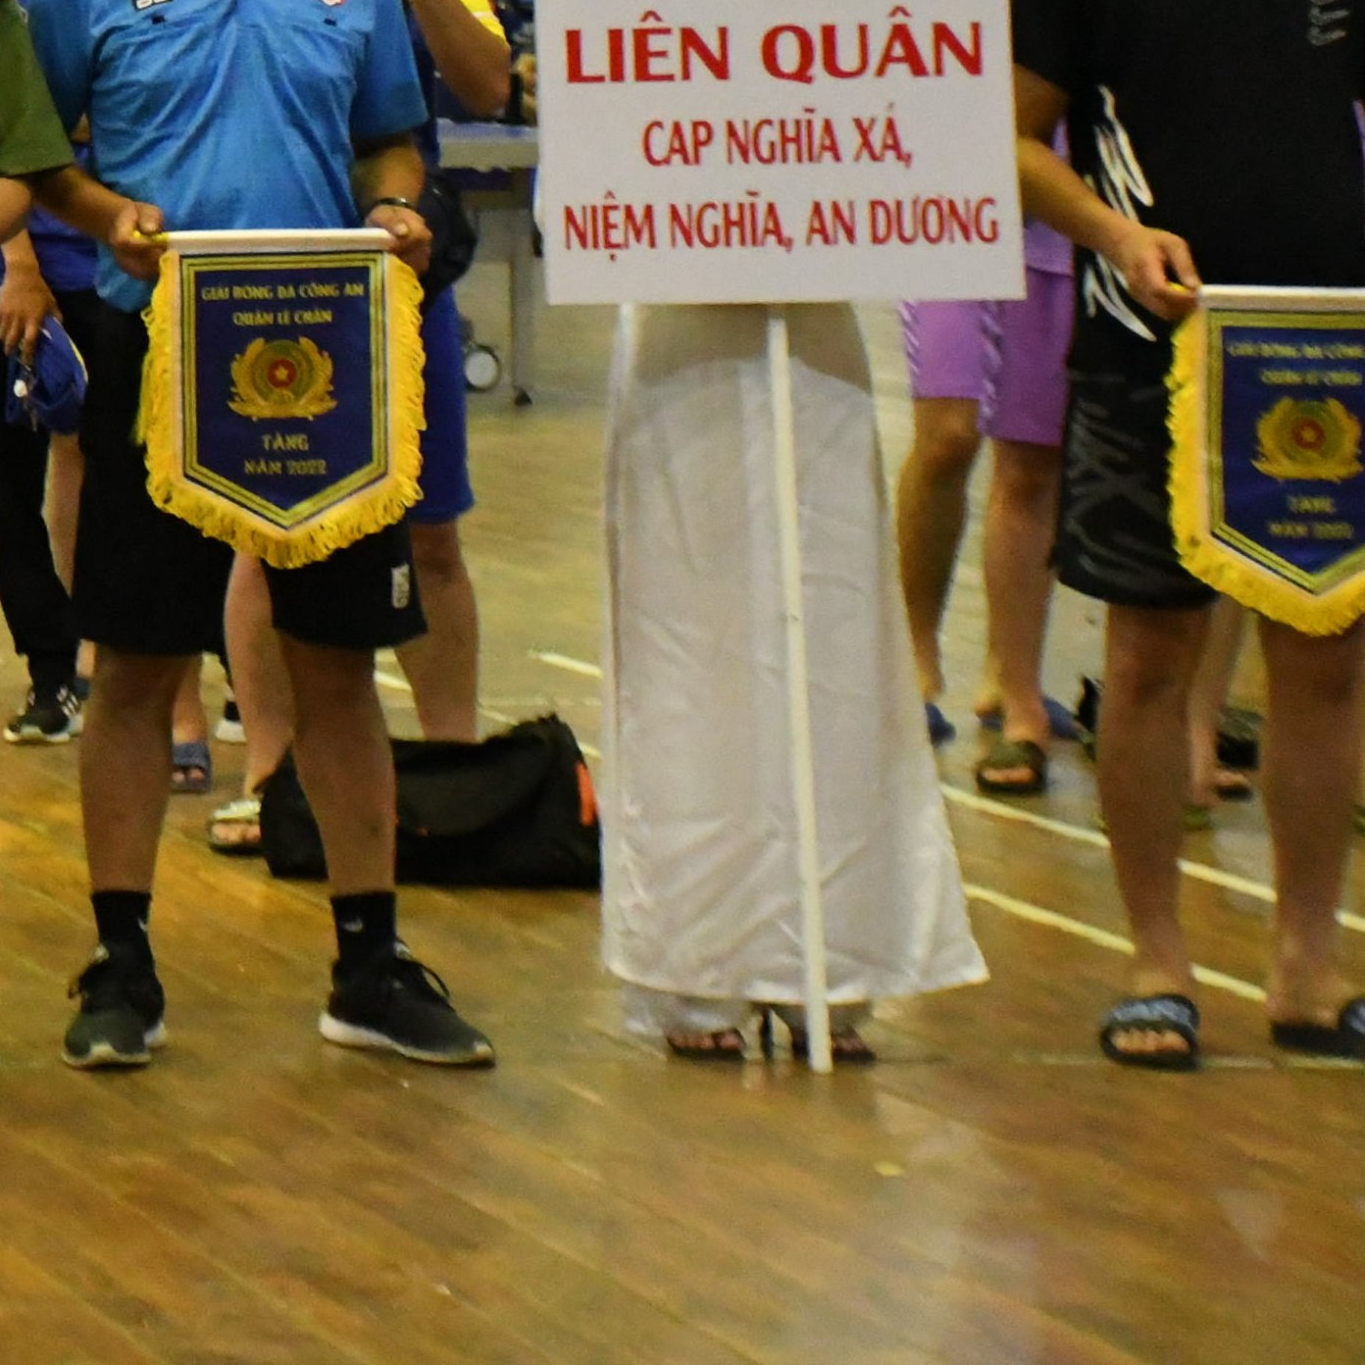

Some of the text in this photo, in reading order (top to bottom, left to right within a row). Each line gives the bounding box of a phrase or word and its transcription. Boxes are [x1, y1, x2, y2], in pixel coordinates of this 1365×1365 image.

[565, 6, 983, 85] LIÊN QUÂN
[642, 119, 713, 167] CAP
[727, 107, 842, 165] NGHĨA
[563, 190, 657, 262] NIỆM
[670, 190, 793, 254] NGHĨA,
[805, 199, 857, 247] AN
